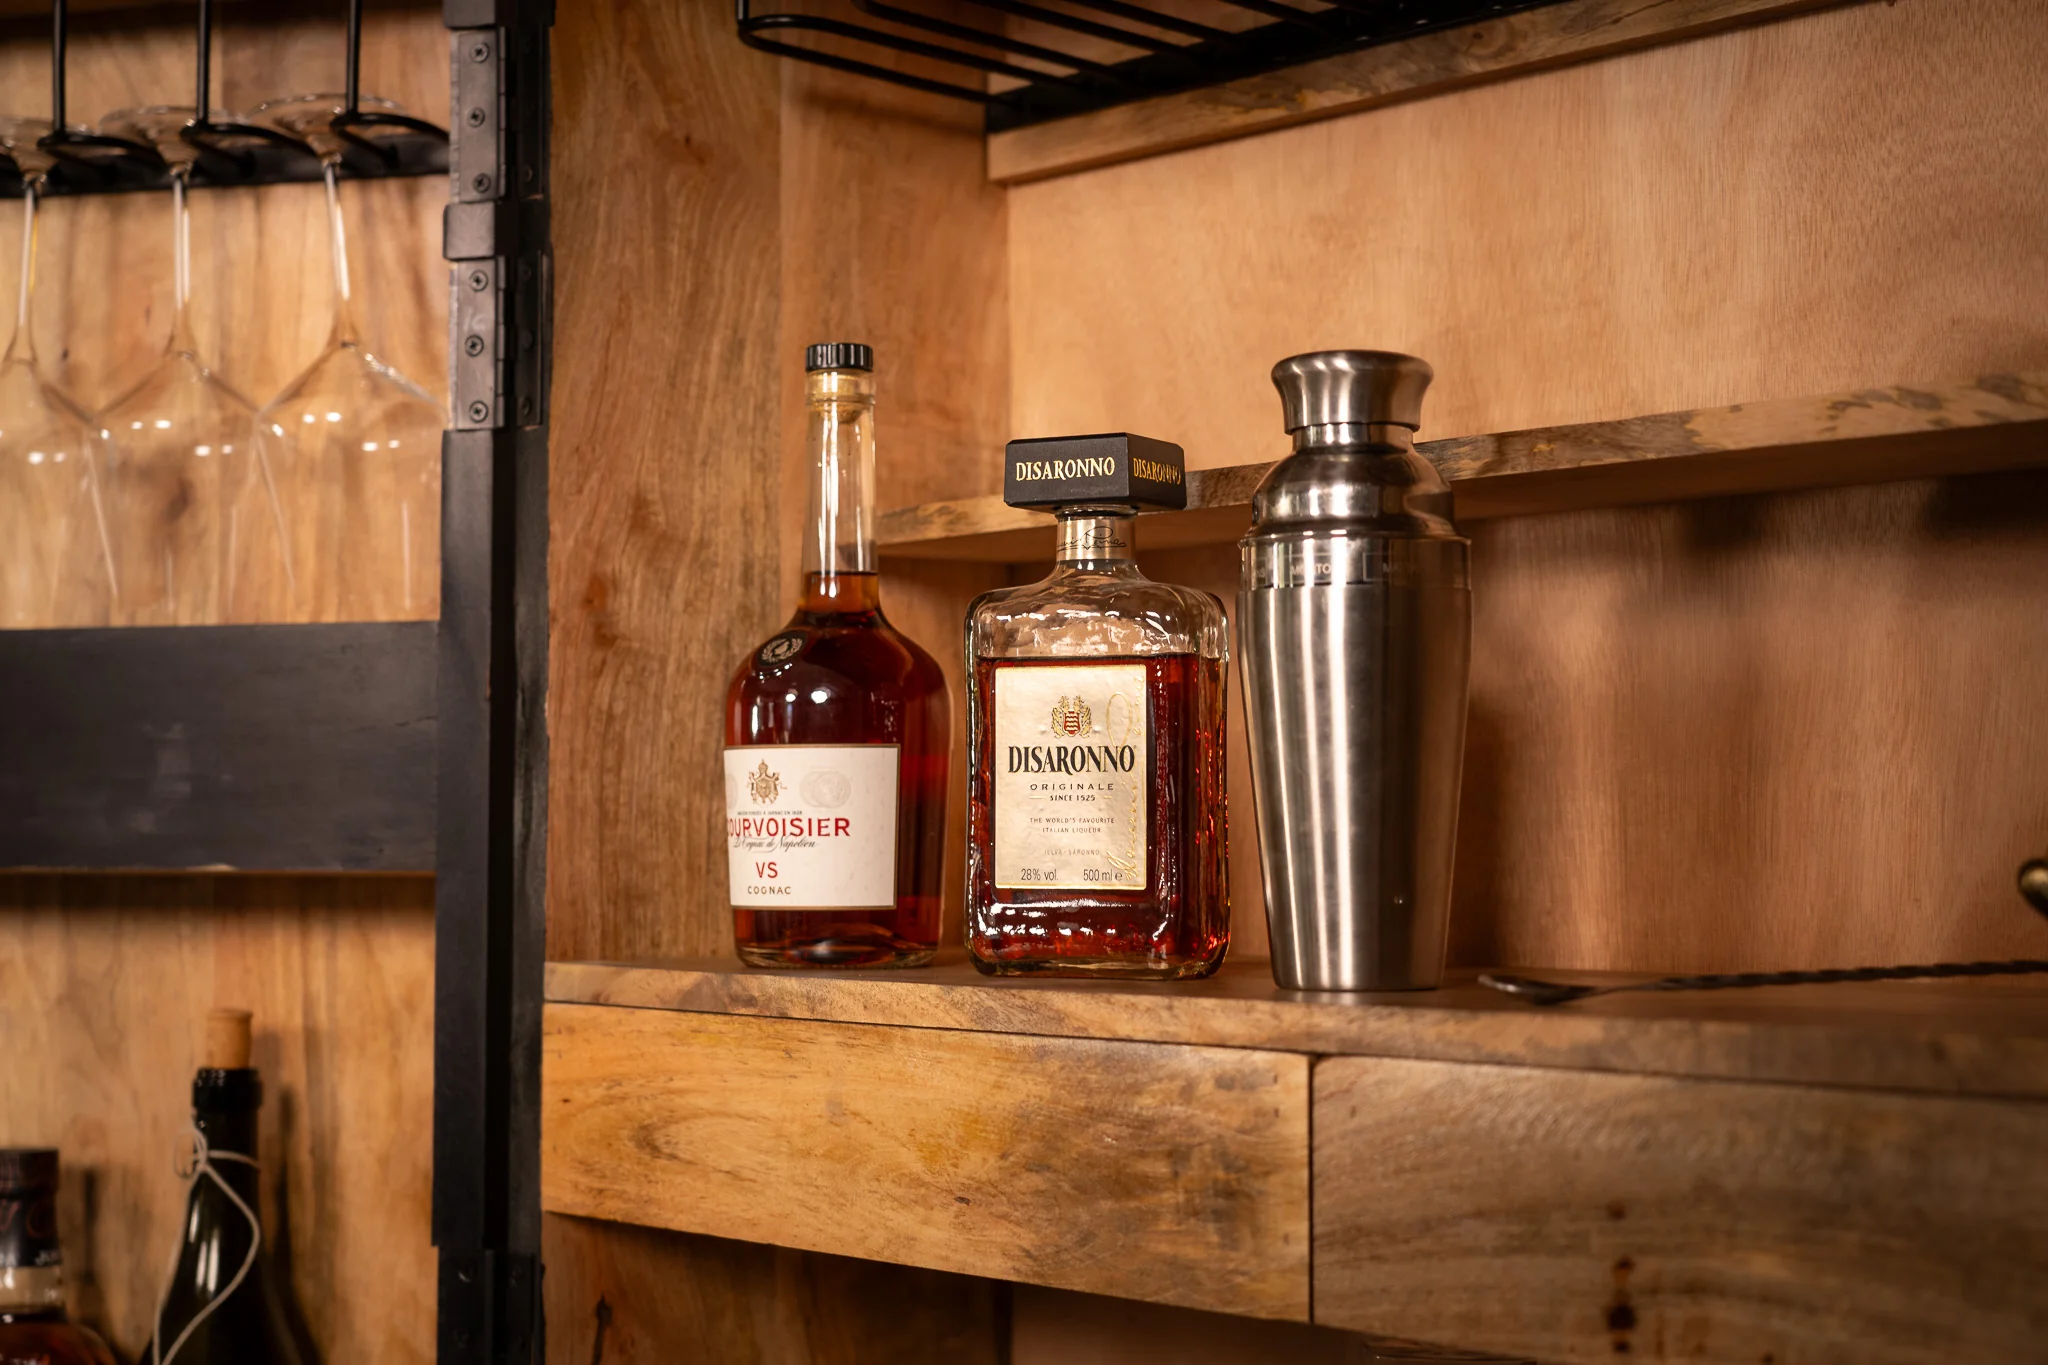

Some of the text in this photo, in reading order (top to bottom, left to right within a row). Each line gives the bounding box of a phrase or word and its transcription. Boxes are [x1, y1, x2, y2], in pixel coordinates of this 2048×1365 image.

[1016, 456, 1115, 481] DISARONNO
[1132, 457, 1182, 485] DISARONNO
[1008, 745, 1135, 776] DISARONNO
[1030, 783, 1114, 791] ORIGINALE
[1049, 794, 1096, 802] SINCE 1525
[1043, 827, 1101, 835] ITALIAN LIQUEUR
[756, 862, 778, 878] VS
[1020, 868, 1042, 881] 28%
[1044, 868, 1059, 881] vol.
[1083, 868, 1100, 881] 500
[1101, 868, 1113, 881] ml
[748, 886, 791, 894] COGNAC
